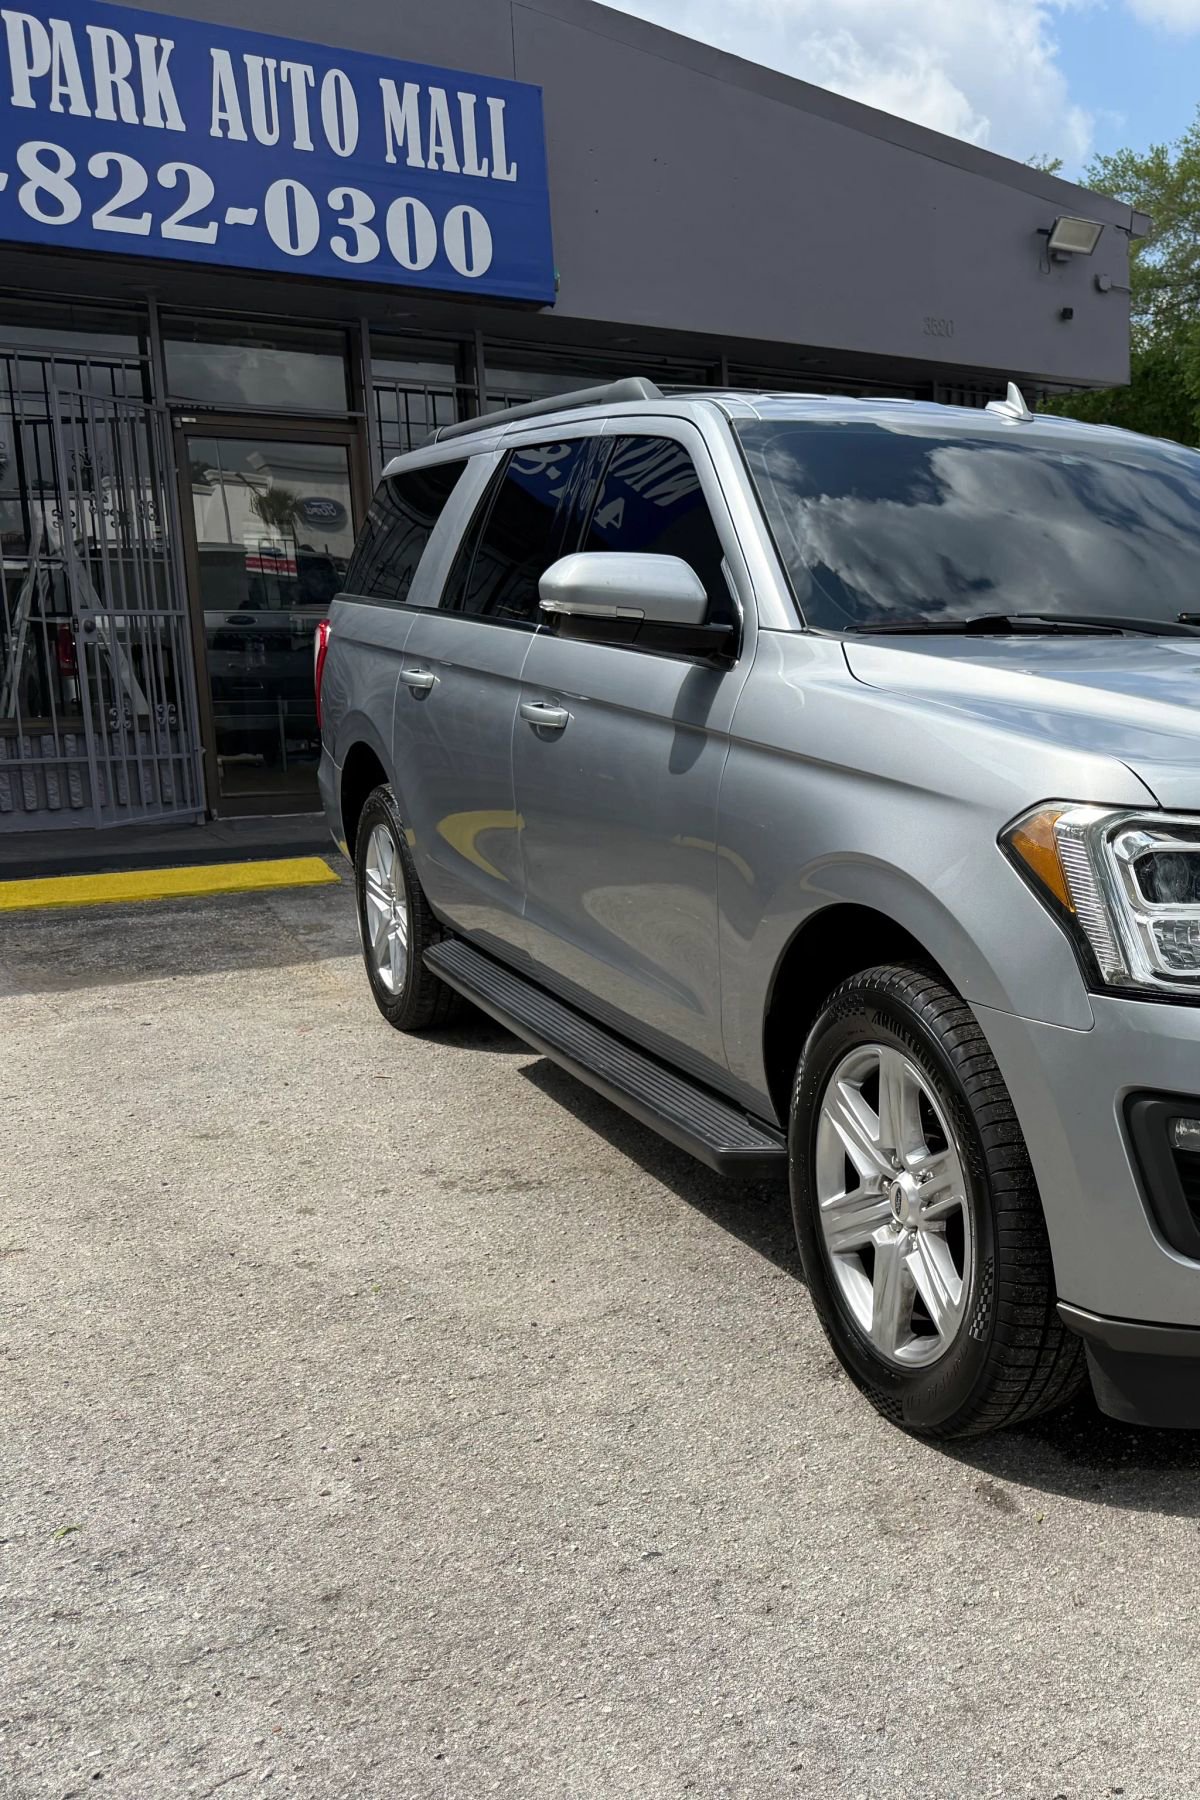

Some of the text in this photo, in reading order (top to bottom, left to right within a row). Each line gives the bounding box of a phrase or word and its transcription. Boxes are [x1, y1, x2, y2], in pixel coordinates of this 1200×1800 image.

[1, 9, 517, 181] PARK AUTO MALL
[0, 141, 493, 278] 822-0300
